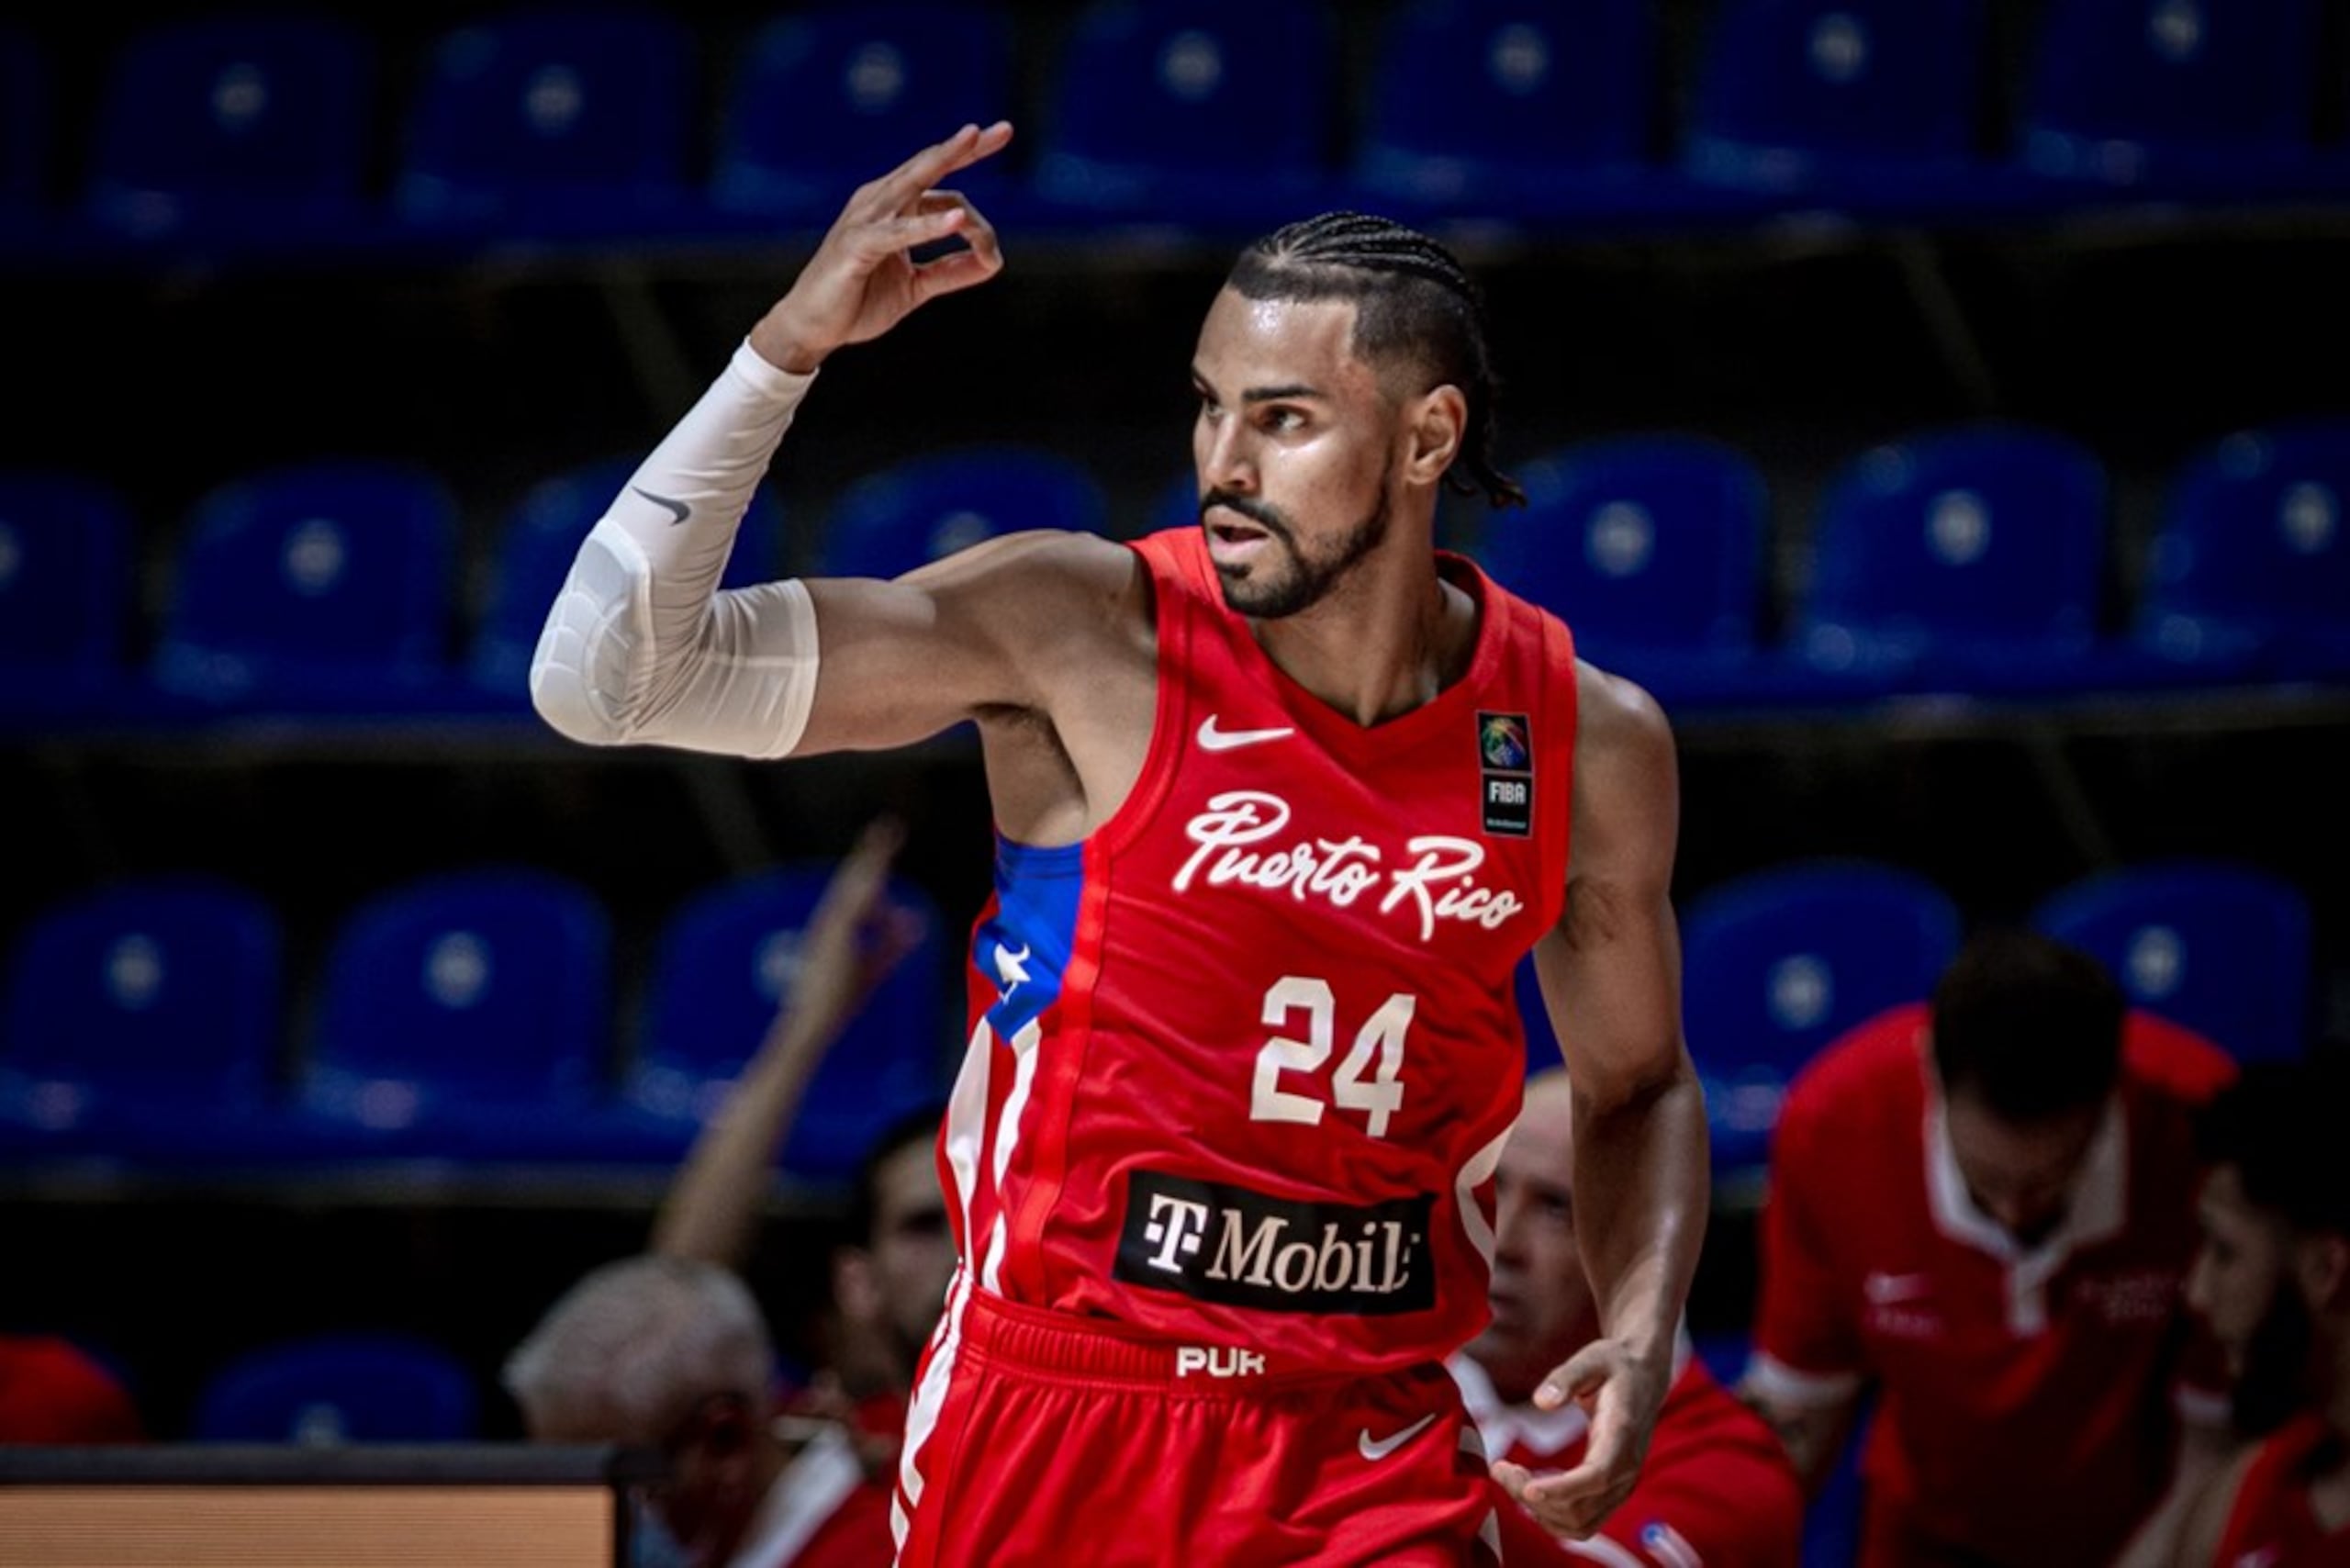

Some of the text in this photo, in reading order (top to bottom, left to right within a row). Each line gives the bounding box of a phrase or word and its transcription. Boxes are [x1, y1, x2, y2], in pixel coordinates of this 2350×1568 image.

[1171, 790, 1524, 944] Puerto Rico
[1488, 780, 1528, 805] FIBA
[1249, 975, 1417, 1138] 24
